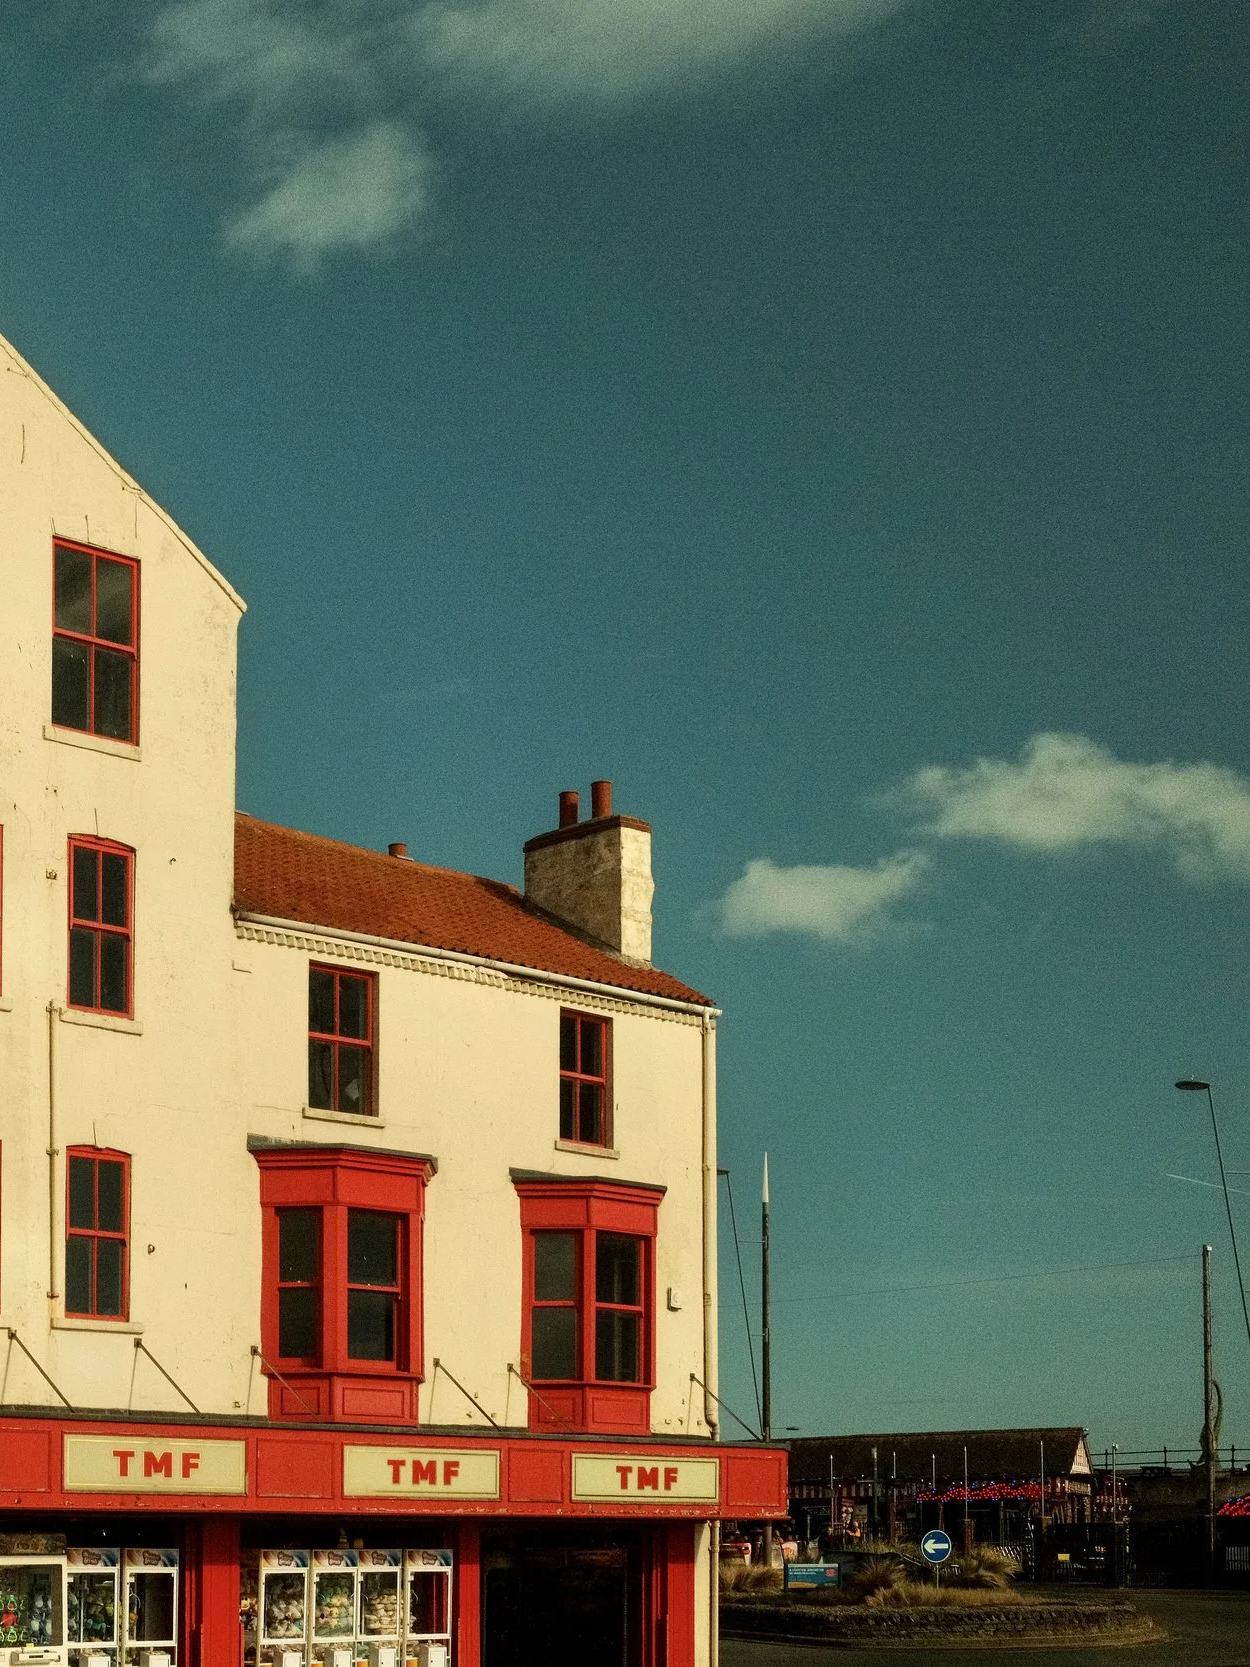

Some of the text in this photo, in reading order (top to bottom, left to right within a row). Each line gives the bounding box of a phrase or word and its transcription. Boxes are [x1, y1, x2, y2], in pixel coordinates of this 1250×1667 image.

[112, 1449, 201, 1479] TMF
[387, 1458, 461, 1486] TMF
[615, 1465, 680, 1492] TMF
